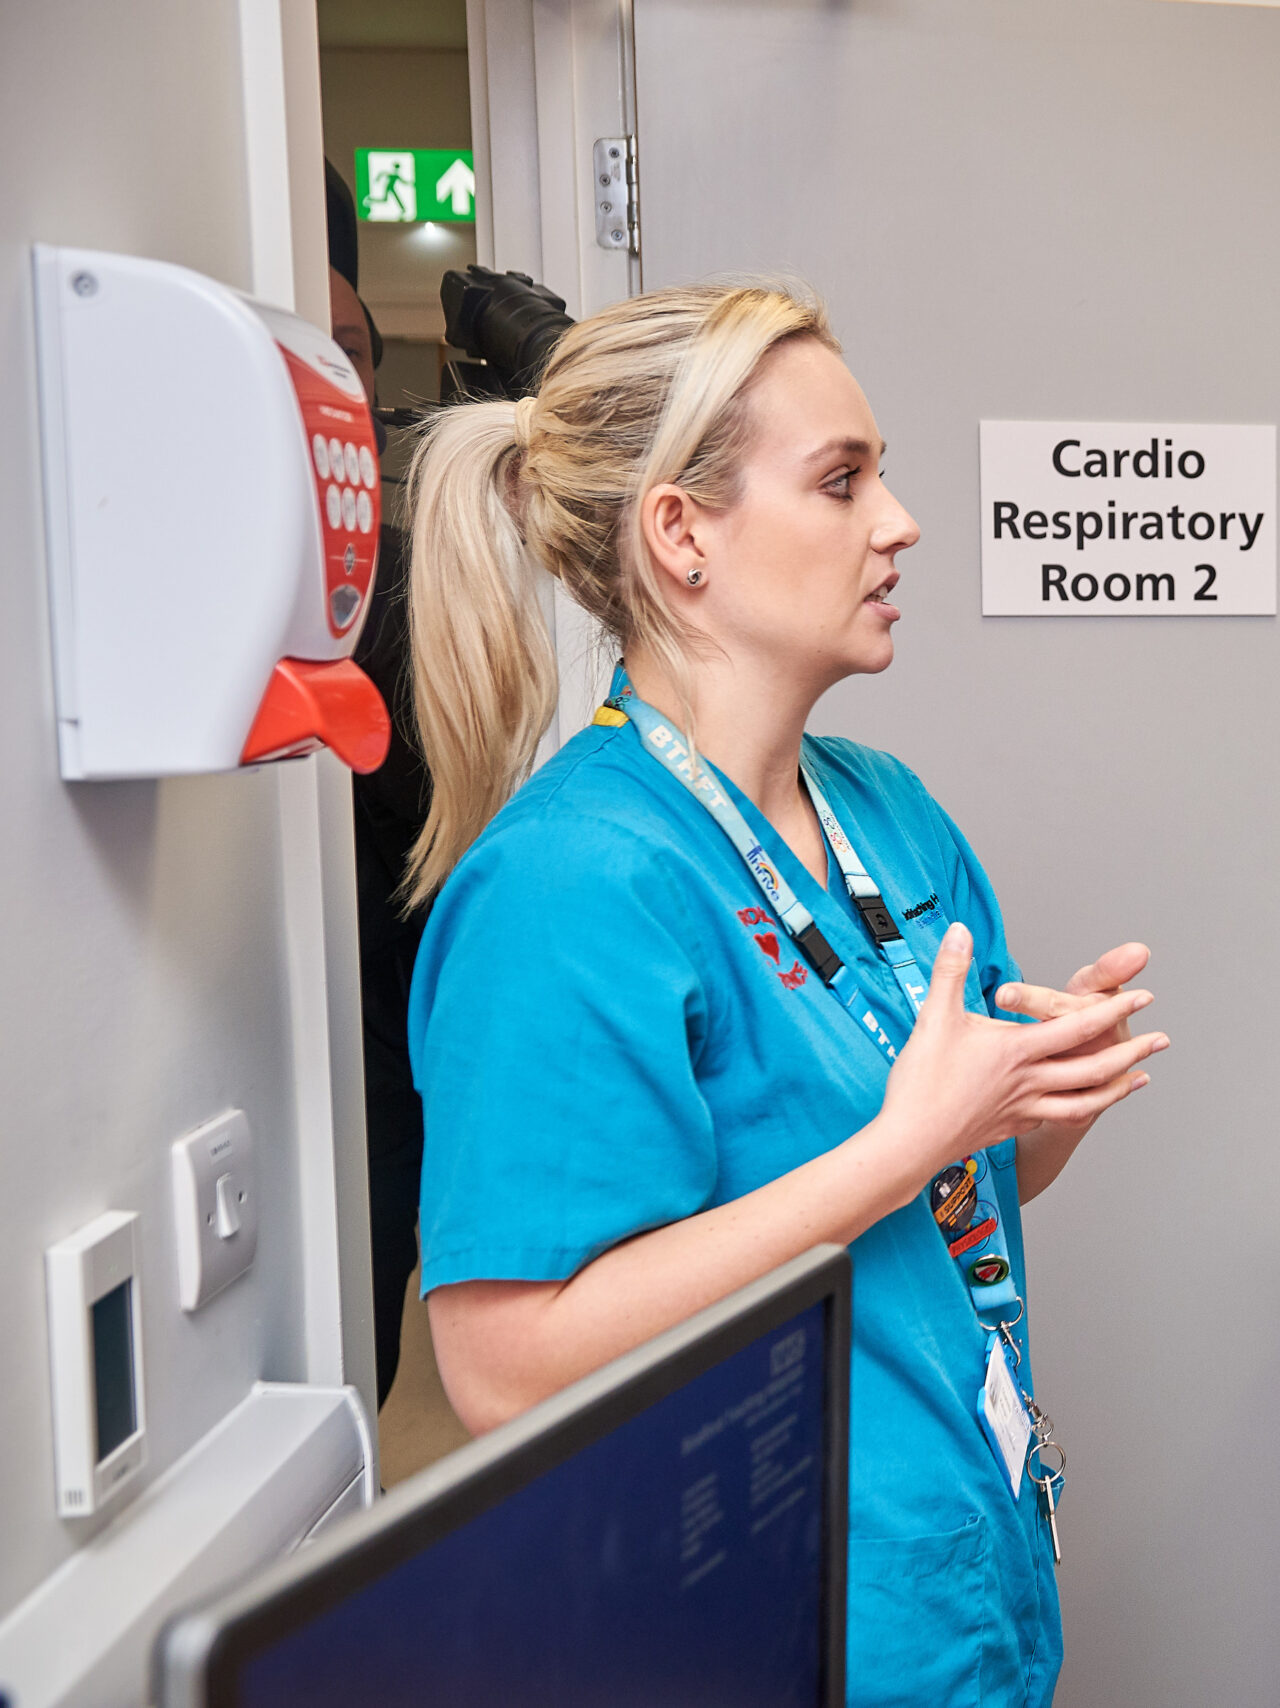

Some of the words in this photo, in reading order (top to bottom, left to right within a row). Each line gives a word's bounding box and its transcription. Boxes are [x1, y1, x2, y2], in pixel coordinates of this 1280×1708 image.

[1052, 438, 1205, 479] Cardio
[992, 500, 1264, 551] Respiratory
[1041, 564, 1175, 601] Room
[1193, 564, 1218, 601] 2
